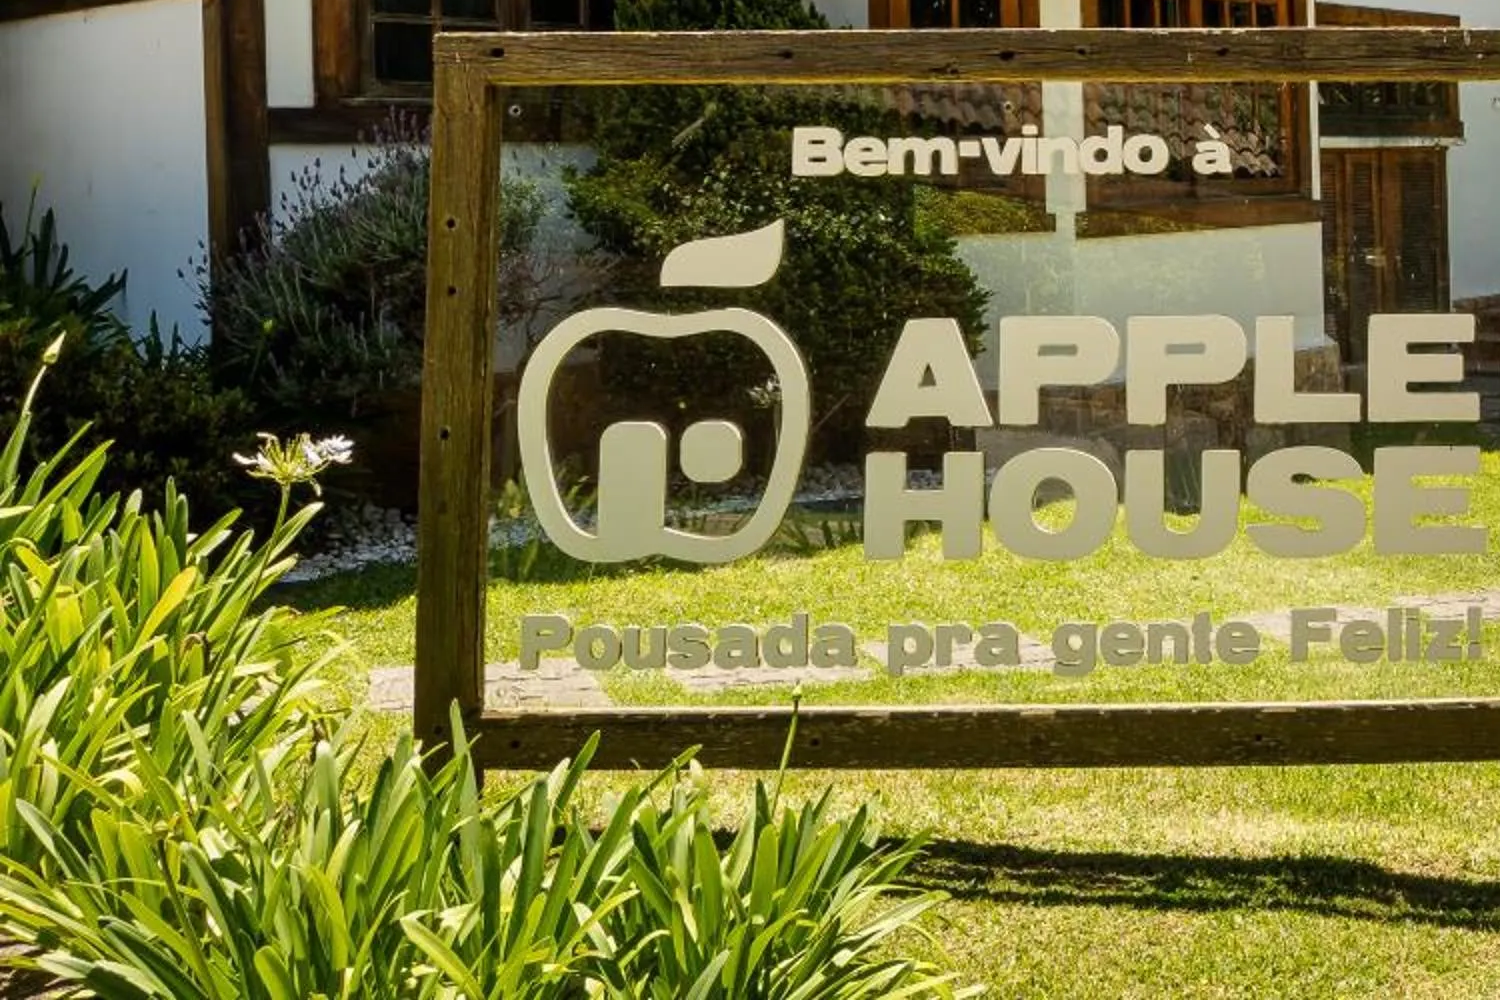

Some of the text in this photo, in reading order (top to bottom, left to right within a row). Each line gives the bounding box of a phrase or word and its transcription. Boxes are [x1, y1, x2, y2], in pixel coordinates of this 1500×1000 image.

[791, 124, 1232, 177] Bem-vindo à
[866, 314, 1480, 427] APPLE
[864, 446, 1488, 560] HOUSE
[519, 606, 1482, 676] Pousada pra gente Feliz!
